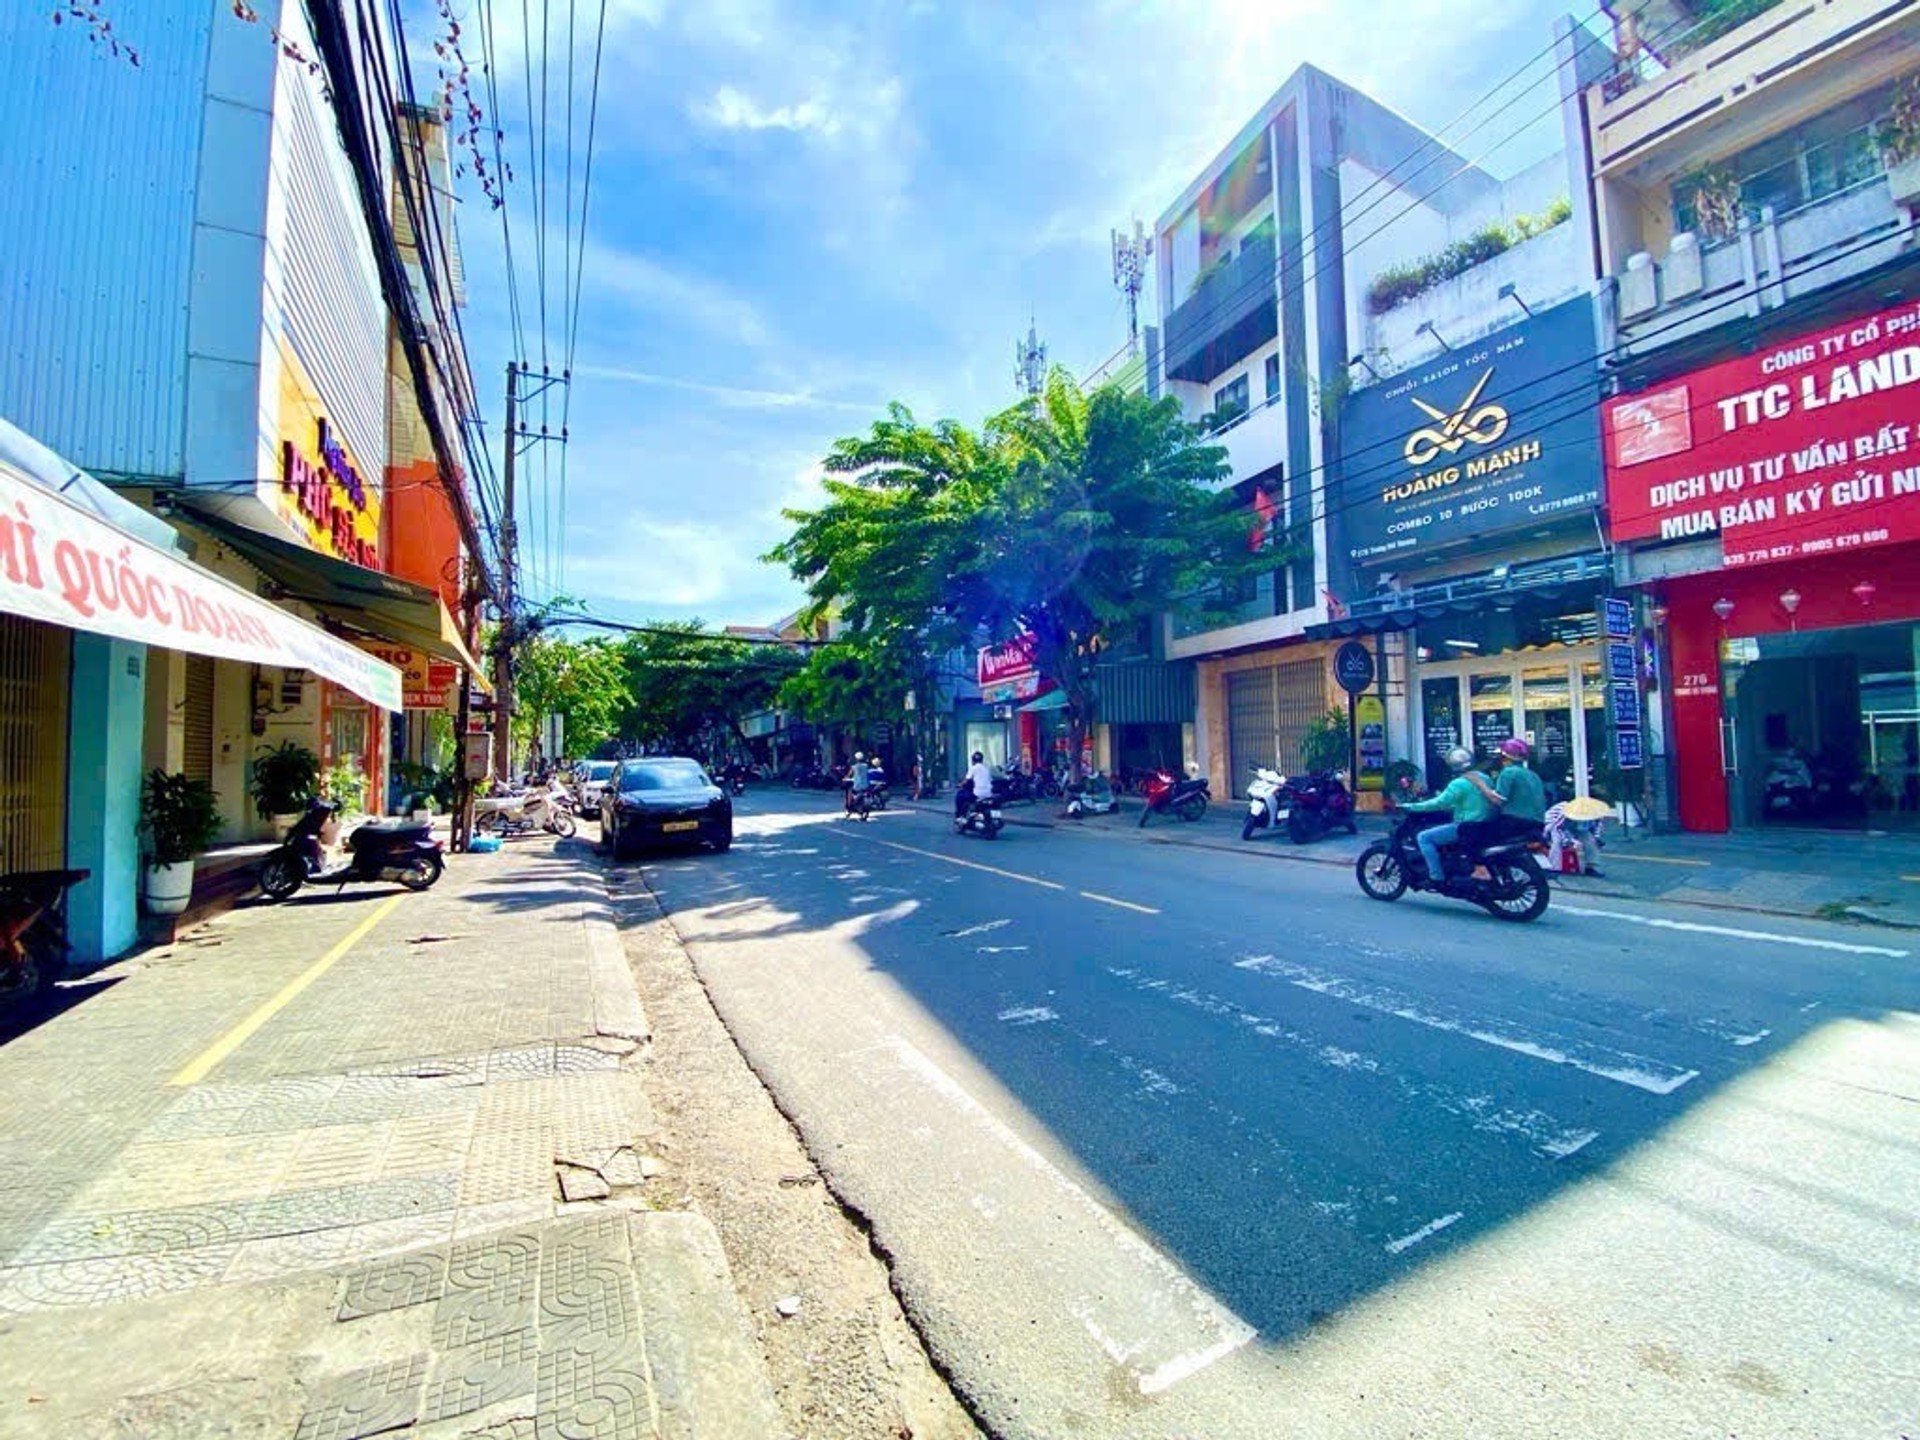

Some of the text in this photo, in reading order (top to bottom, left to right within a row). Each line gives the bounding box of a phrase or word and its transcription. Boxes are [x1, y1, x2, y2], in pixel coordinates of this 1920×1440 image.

[1496, 337, 1525, 354] NAM
[1762, 344, 1816, 374] CÔNG
[1819, 334, 1846, 356] TY
[1850, 317, 1880, 347] CỔ
[1717, 346, 1920, 433] TTC LAND
[1382, 466, 1460, 503] HOÀNG
[1466, 440, 1541, 477] MẠNH
[1650, 474, 1706, 508] DỊCH
[1709, 465, 1744, 493] VỤ
[1748, 453, 1787, 484] TƯ
[1791, 437, 1848, 474] VẤN
[1660, 510, 1717, 541] MUA
[1719, 497, 1776, 529] BÁN
[1786, 482, 1824, 516] KÝ
[1831, 469, 1884, 506] GỬI
[1386, 515, 1433, 534] COMBO
[1508, 485, 1543, 502] 100K
[54, 539, 172, 626] QUỐC
[171, 584, 281, 650] DOANH
